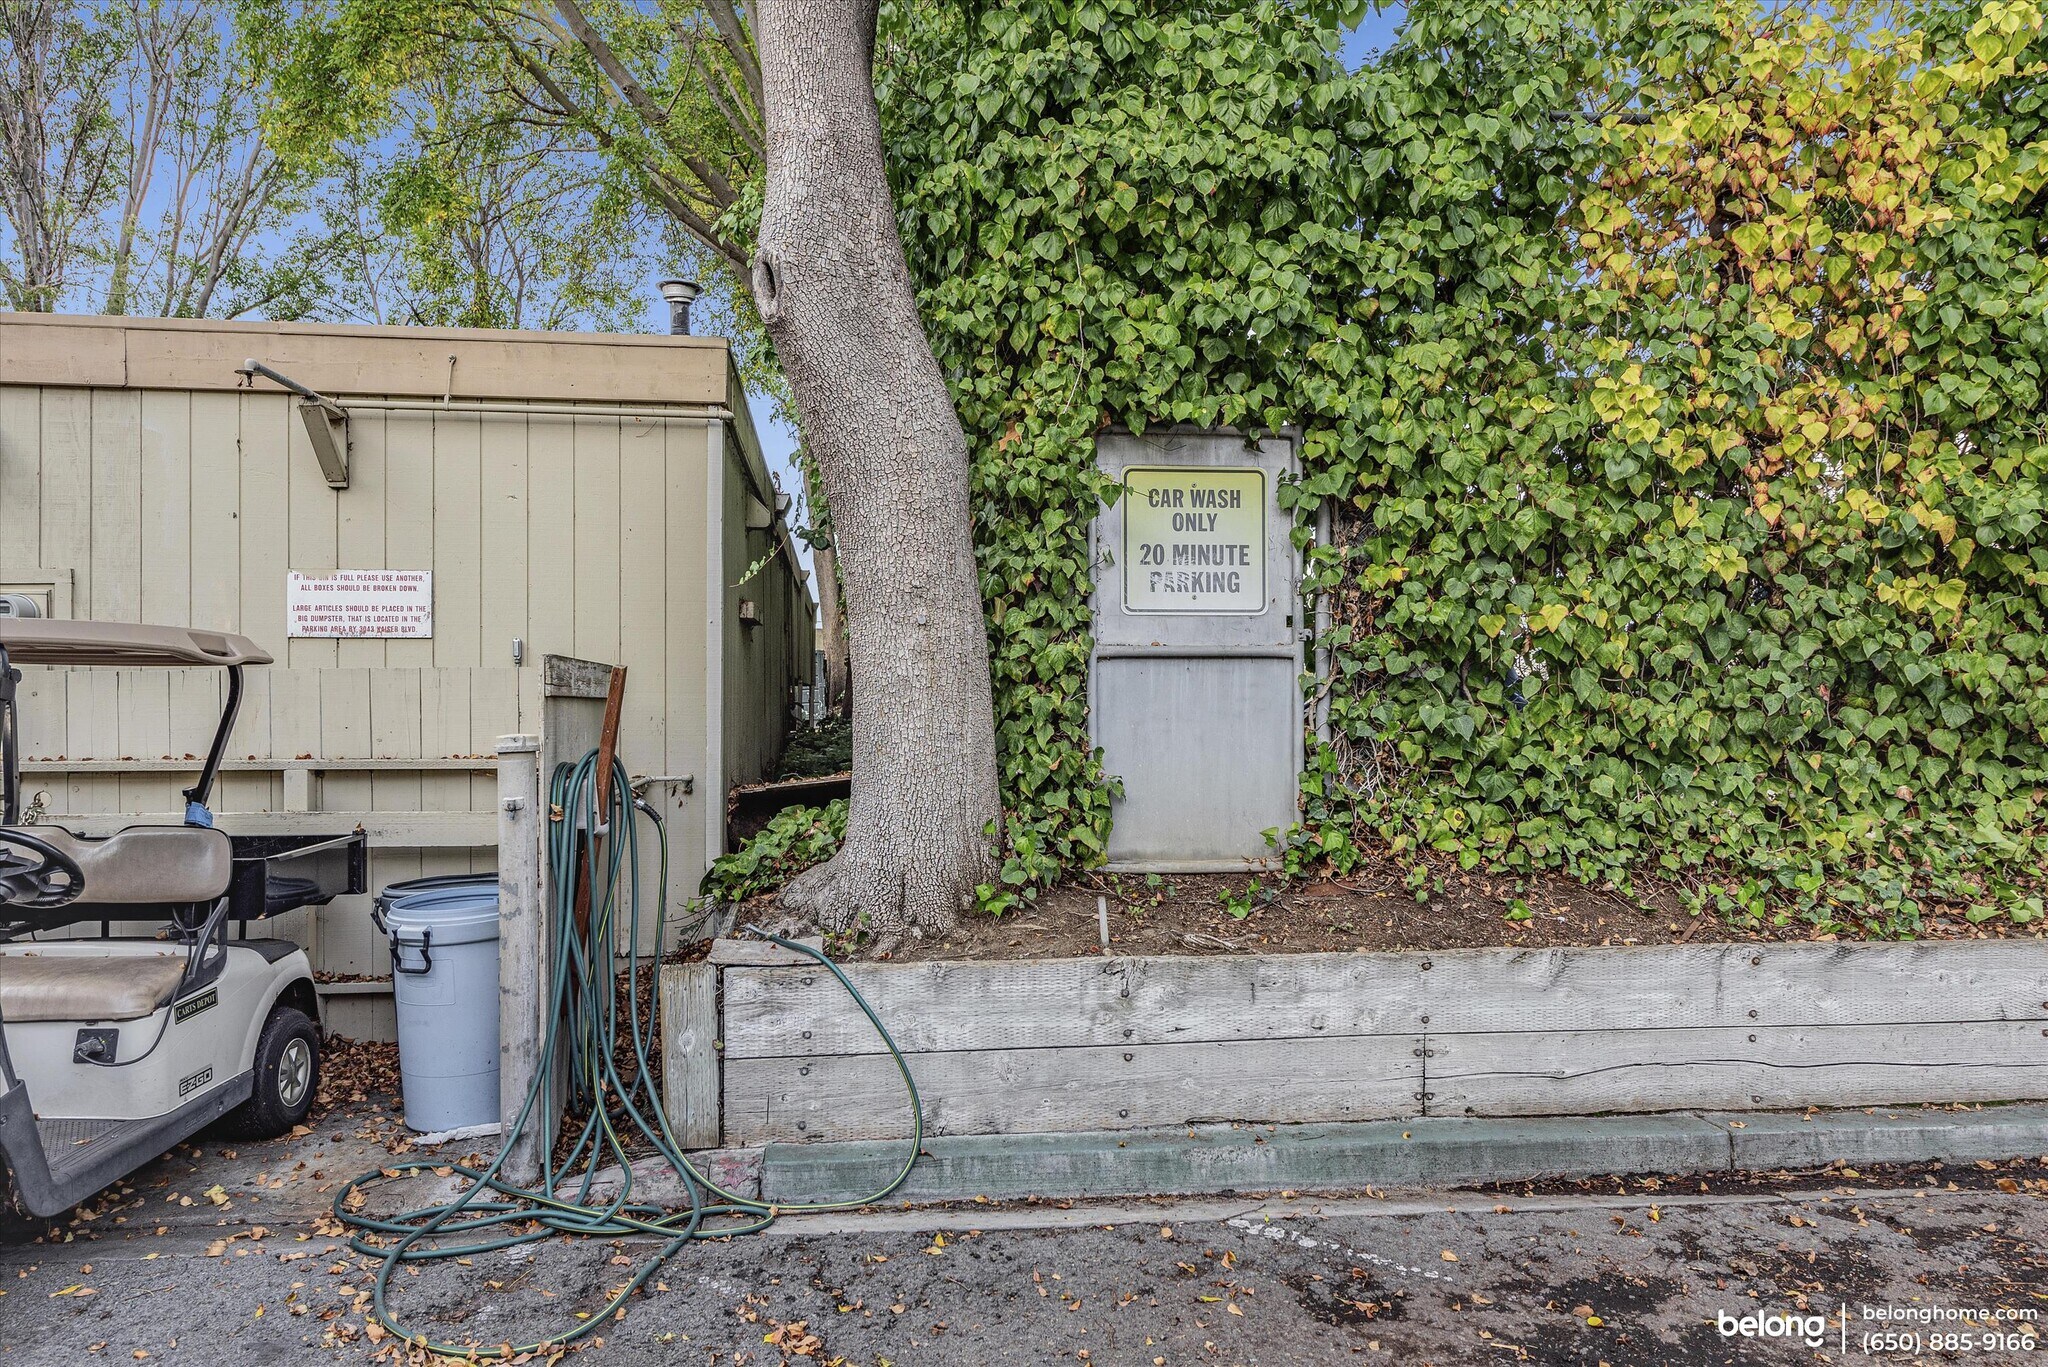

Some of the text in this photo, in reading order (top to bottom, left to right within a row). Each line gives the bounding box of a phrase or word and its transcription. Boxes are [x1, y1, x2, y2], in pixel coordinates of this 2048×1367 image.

[1148, 488, 1241, 508] CAR WASH
[1172, 512, 1218, 532] ONLY
[1139, 543, 1250, 566] 20 MINUTE
[314, 584, 334, 592] BOXES
[337, 584, 360, 592] SHOULD
[363, 584, 370, 592] BE
[373, 584, 397, 592] BROKEN
[396, 574, 425, 582] ANOTHER,
[177, 994, 216, 1018] CARTS DEPOT
